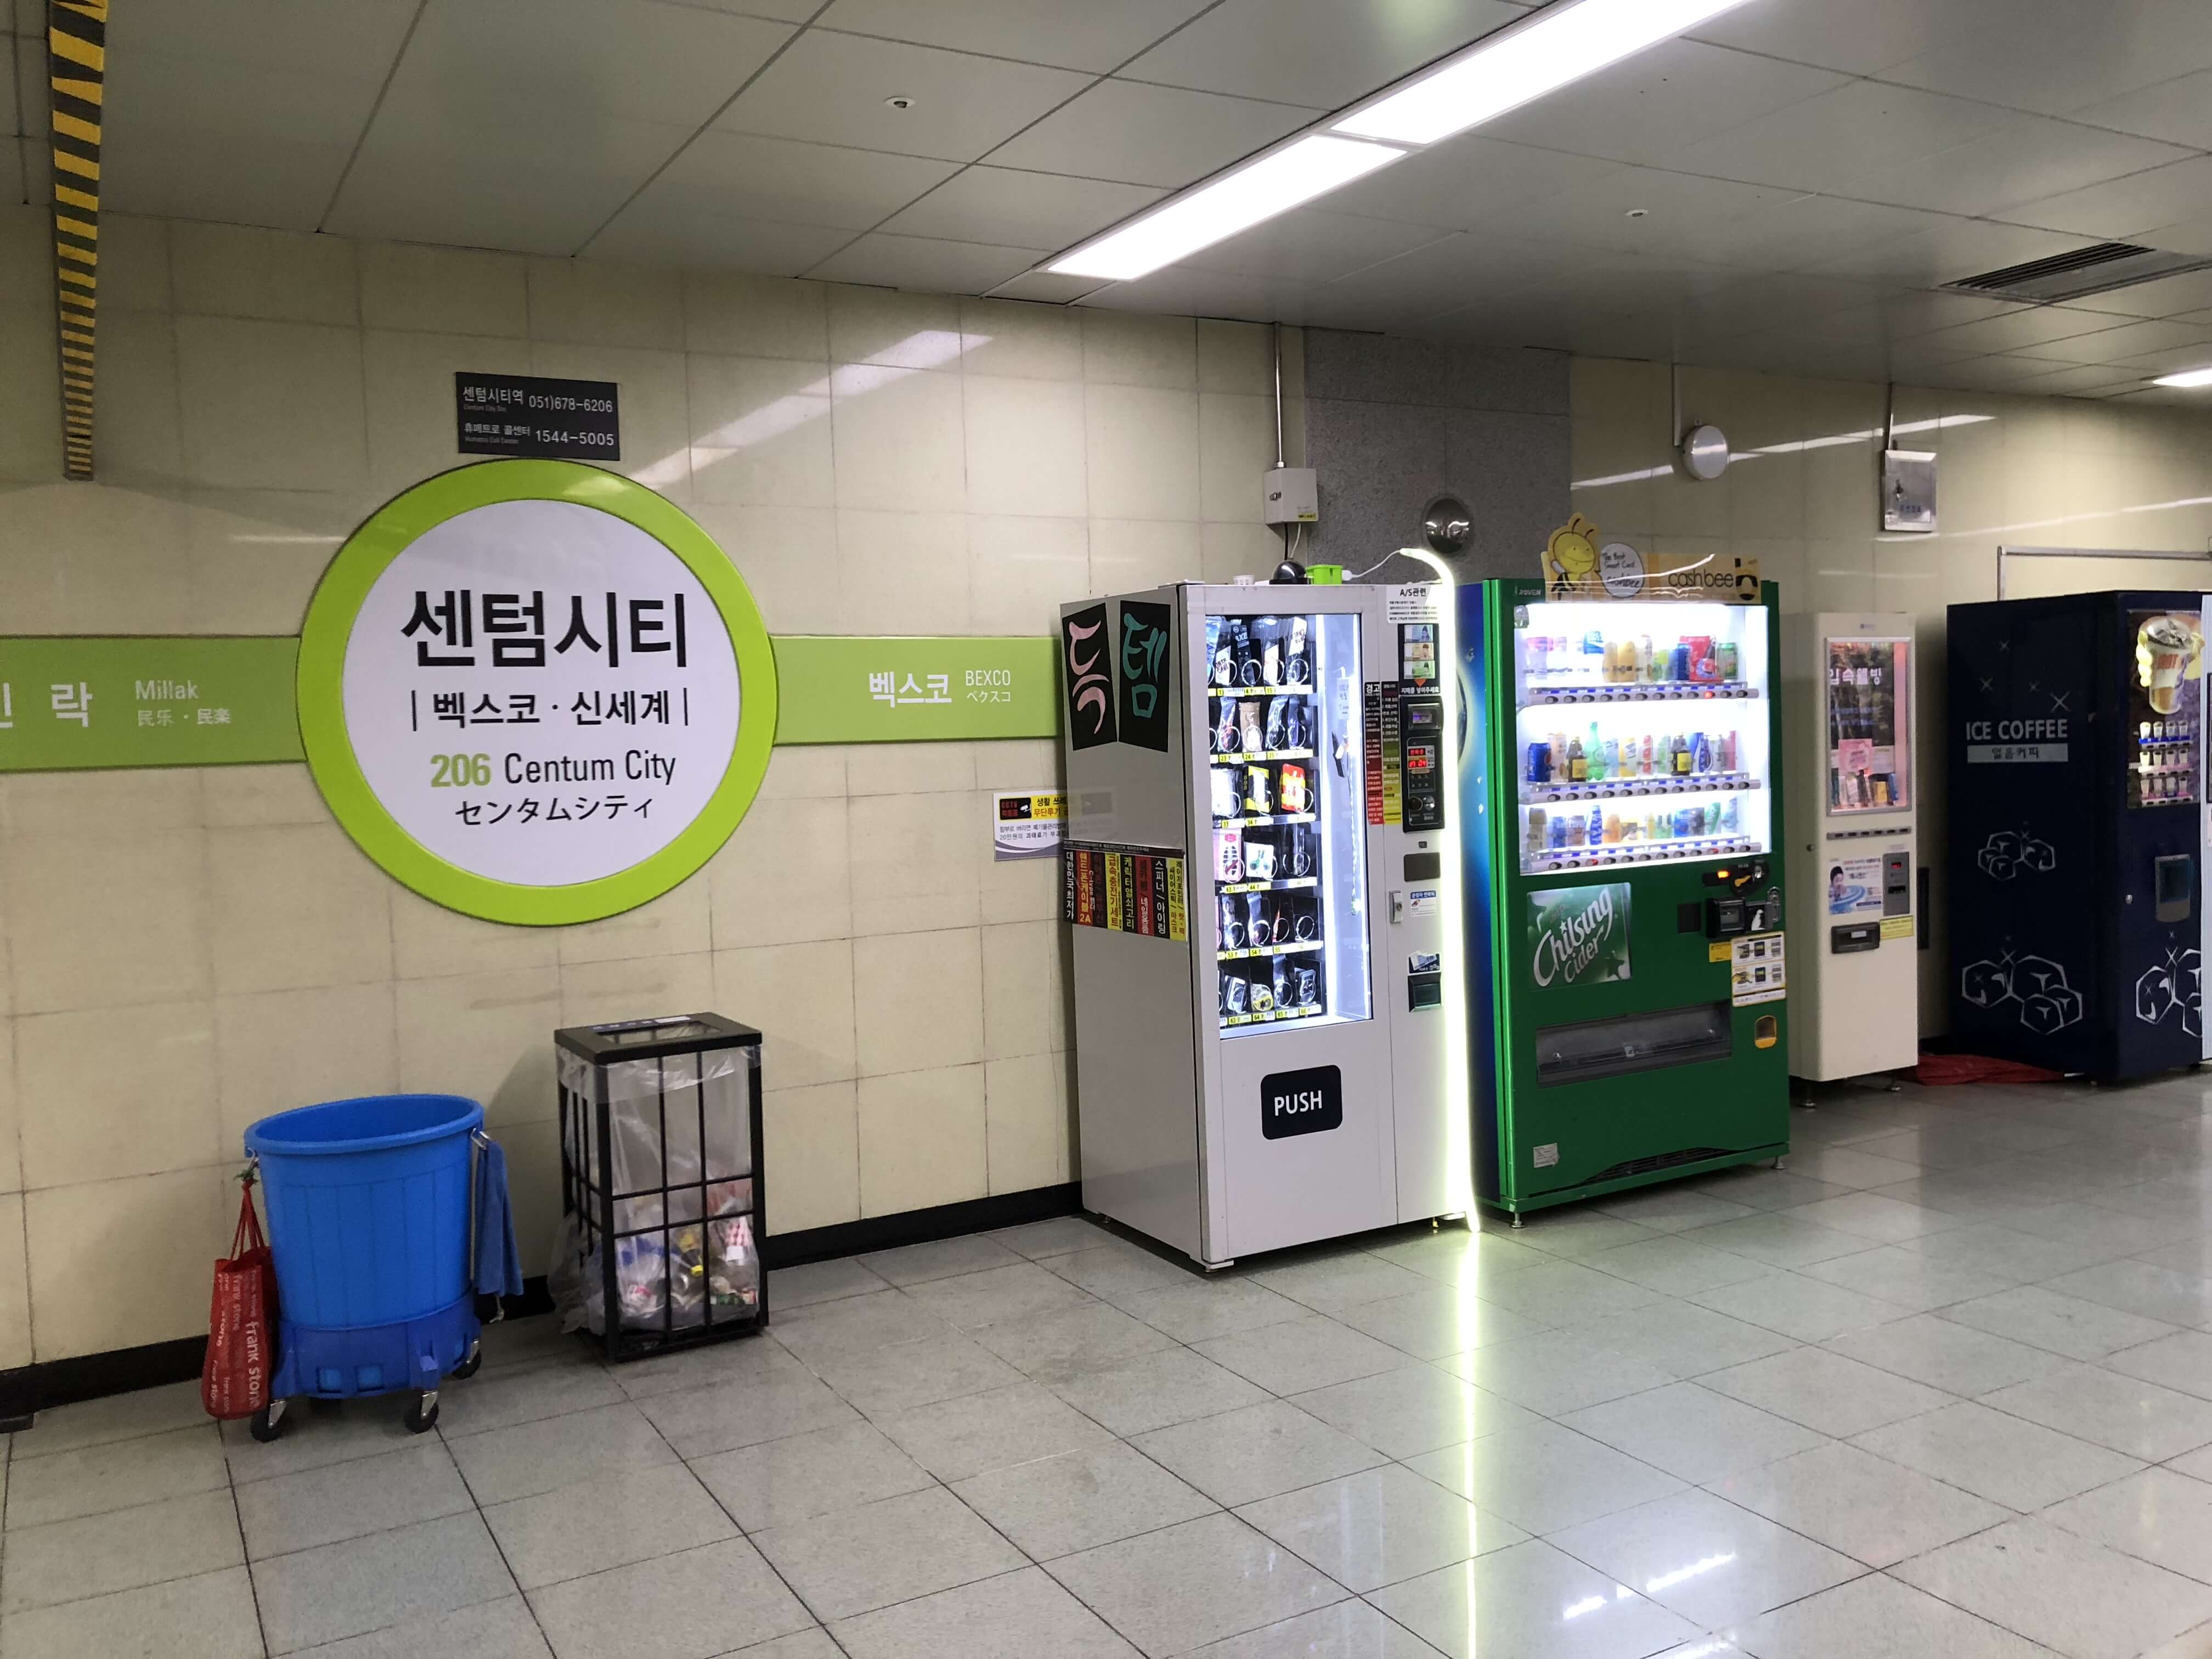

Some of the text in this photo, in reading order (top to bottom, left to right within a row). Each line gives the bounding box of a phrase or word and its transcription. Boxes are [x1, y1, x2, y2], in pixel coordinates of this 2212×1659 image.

[463, 386, 613, 413] 센텀시티역 051)678-6206
[465, 422, 614, 446] 휴메트로 콜센터 1544-5005
[1668, 569, 1734, 588] cashbee
[400, 590, 686, 668] 센텀시티
[135, 680, 199, 700] Millak
[869, 672, 952, 708] 벡스코
[965, 670, 1011, 686] BEXCO
[1366, 684, 1380, 693] 경고
[433, 690, 669, 728] 벡스코 신세계
[967, 691, 1011, 703] ベクスコ
[1966, 719, 2068, 741] ICE COFFEE
[1991, 747, 2039, 759] 얼음커피
[430, 750, 676, 787] 206 Centum City
[455, 795, 653, 826] センタムシティ
[1034, 808, 1061, 817] 무단투기
[1036, 797, 1050, 806] 생활
[1155, 860, 1166, 935] 스피너 아이링
[1080, 913, 1091, 923] 2A
[1534, 886, 1613, 986] Chilsung
[1274, 1090, 1322, 1116] PUSH
[245, 1321, 260, 1363] frank
